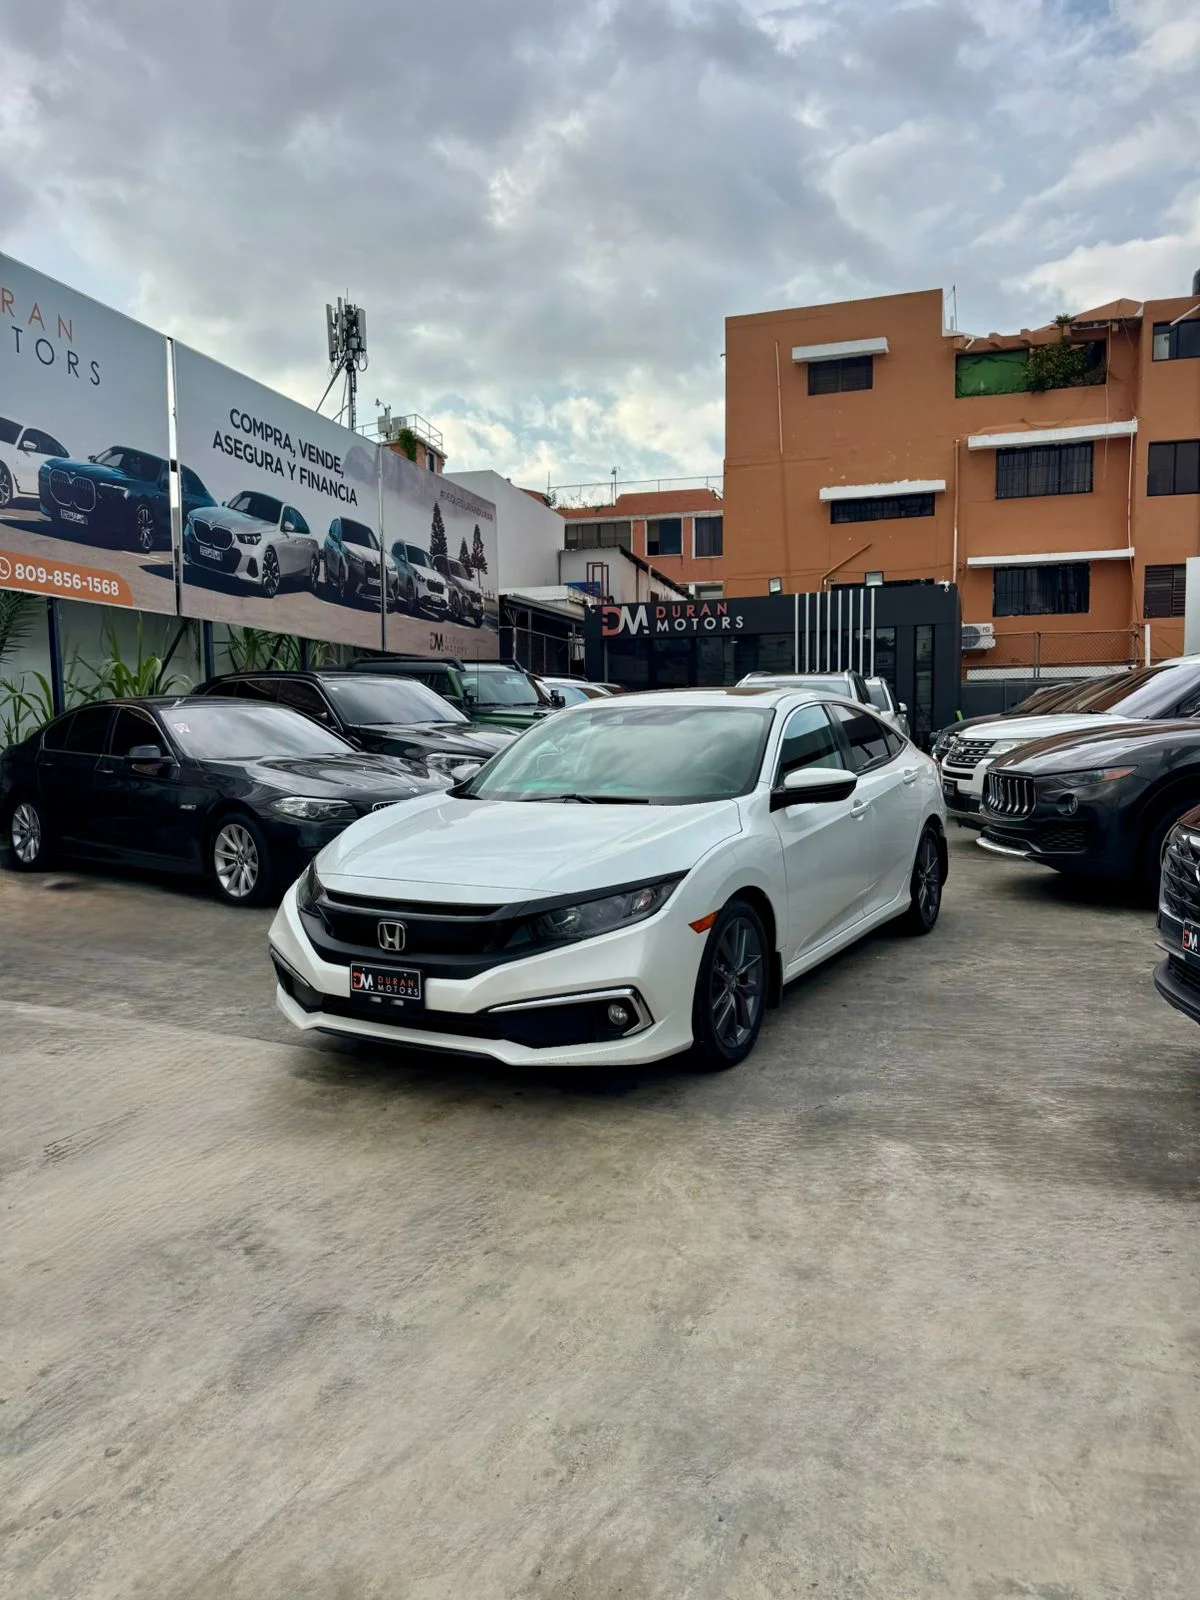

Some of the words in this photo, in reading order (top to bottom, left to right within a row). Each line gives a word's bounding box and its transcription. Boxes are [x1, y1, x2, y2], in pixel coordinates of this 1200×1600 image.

[229, 408, 296, 457] COMPRA,
[298, 438, 344, 478] VENDE,
[212, 430, 285, 477] ASEGURA
[287, 462, 296, 481] Y
[299, 467, 358, 507] FINANCIA
[15, 563, 119, 596] 809-856-1568
[655, 602, 728, 619] DURAN
[656, 616, 744, 633] MOTORS
[378, 976, 414, 987] DURAN
[378, 985, 418, 996] MOTORS
